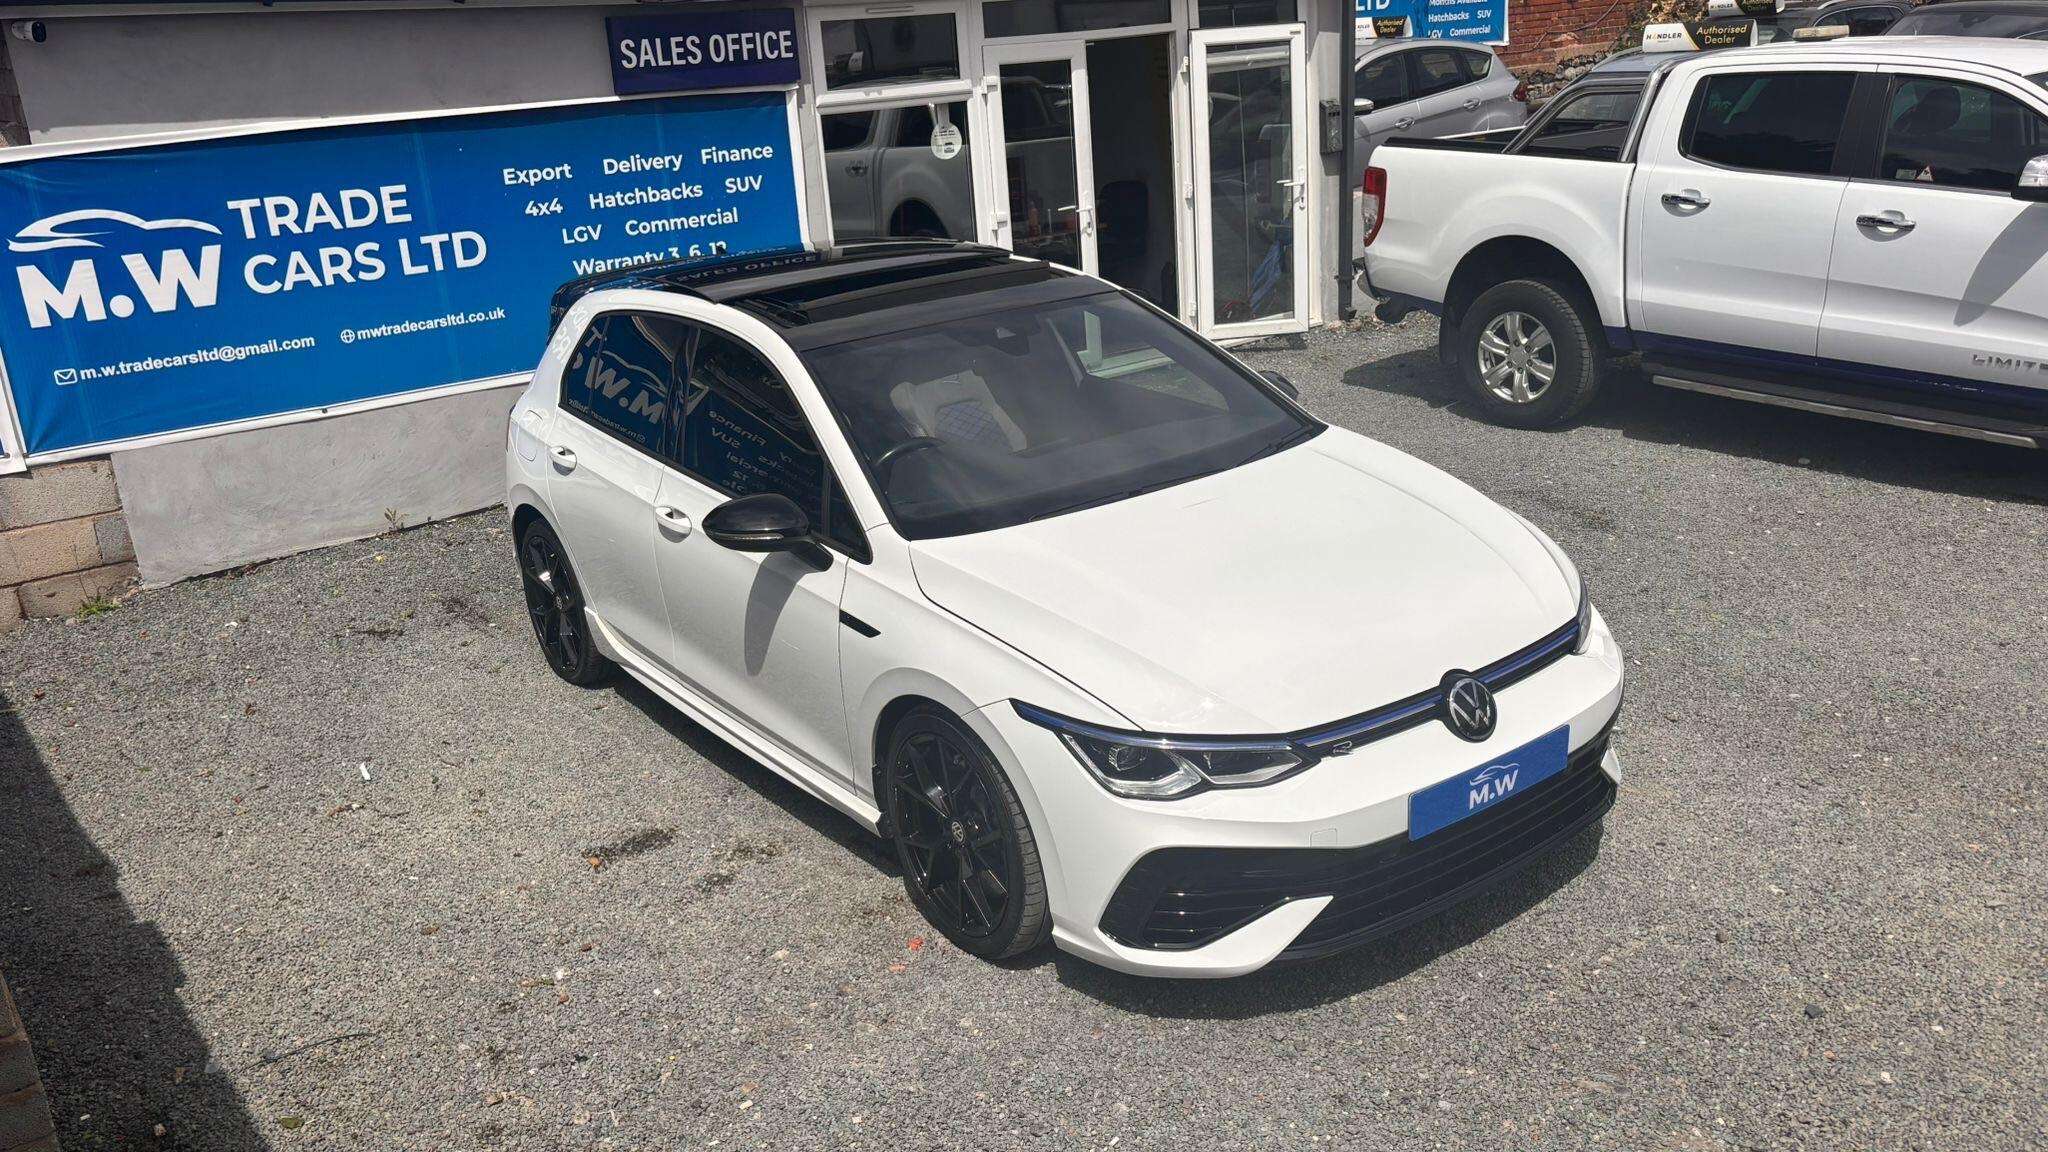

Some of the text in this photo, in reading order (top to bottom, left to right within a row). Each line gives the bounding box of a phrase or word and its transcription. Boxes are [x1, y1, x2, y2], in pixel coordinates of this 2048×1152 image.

[1428, 10, 1492, 22] Hatchbacks SUV
[1450, 25, 1491, 36] Commercial
[1697, 24, 1748, 35] Authorised
[620, 30, 794, 70] SALES OFFICE
[1705, 35, 1736, 44] Dealer
[503, 144, 773, 186] Export Delivery Finance
[227, 184, 412, 240] TRADE
[525, 175, 763, 216] 4x4 Hatchbacks SUV
[562, 208, 738, 244] LGV Commercial
[244, 231, 488, 294] CARS LTD
[573, 252, 664, 275] Warranty
[15, 245, 222, 329] M.W
[357, 307, 505, 340] mwtradecarsltd.co.uk
[80, 335, 315, 381] m.w.tradecarsltd@gmail.com
[1469, 770, 1519, 810] M.W
